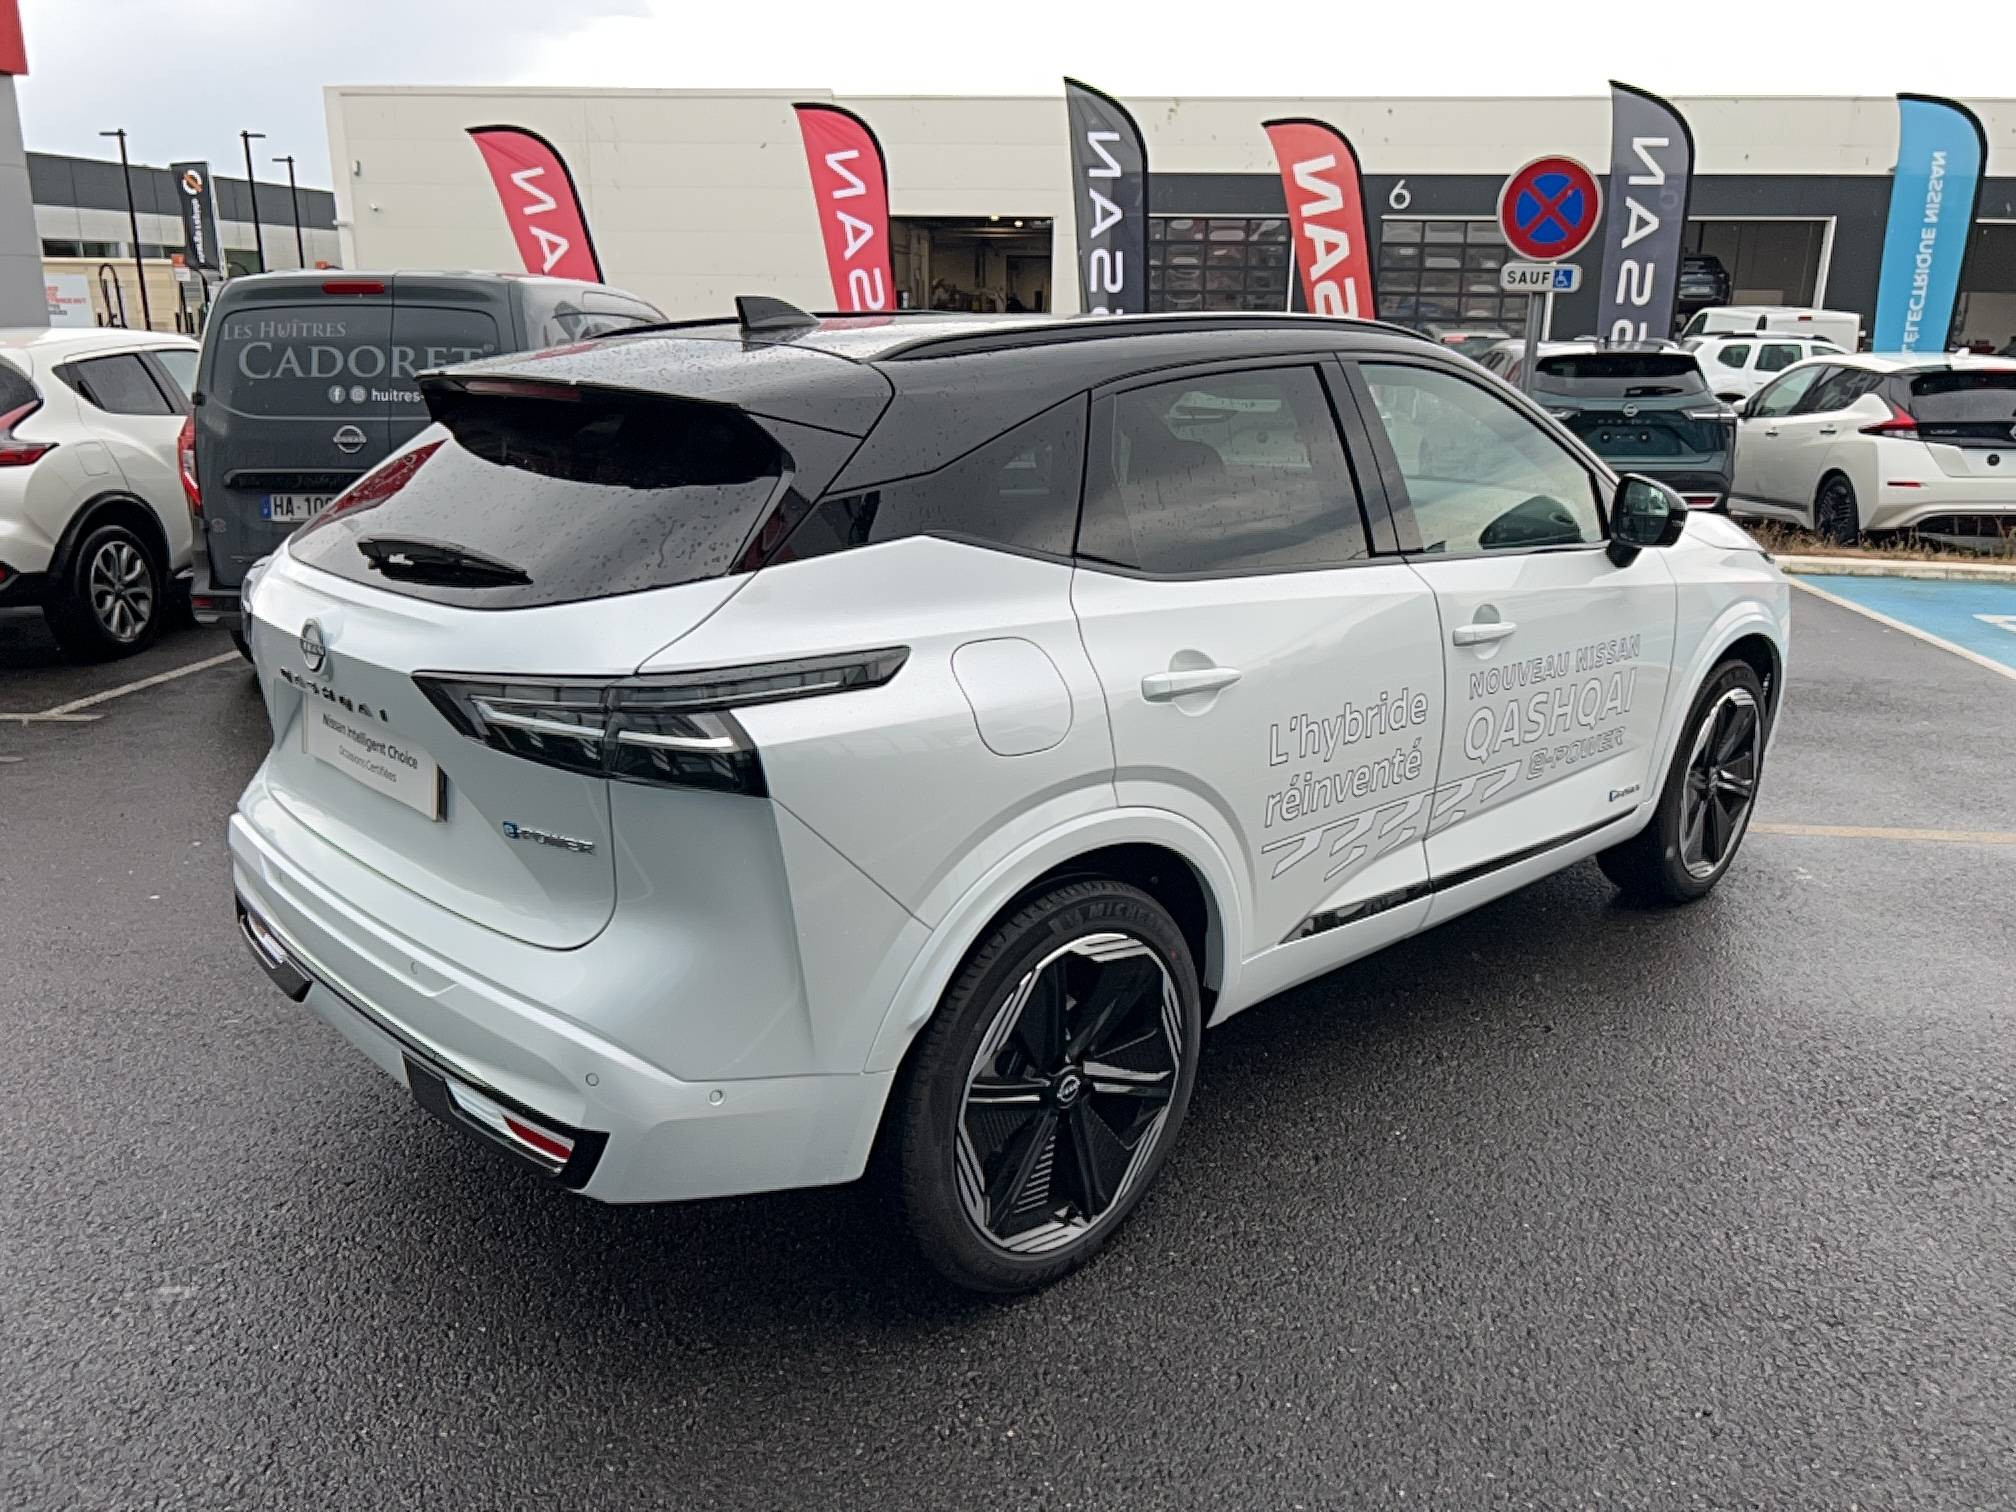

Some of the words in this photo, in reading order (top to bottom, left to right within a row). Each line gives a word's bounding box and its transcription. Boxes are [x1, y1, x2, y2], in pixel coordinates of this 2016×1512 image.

[1389, 179, 1411, 210] 6
[1507, 270, 1551, 285] SAUF
[1469, 651, 1570, 701] NOUVEAU
[1575, 634, 1641, 673] NISSAN
[1269, 687, 1429, 767] L'hybride
[1464, 667, 1638, 764] QASHQAI
[387, 745, 418, 770] Choice
[1264, 737, 1423, 828] réinventé
